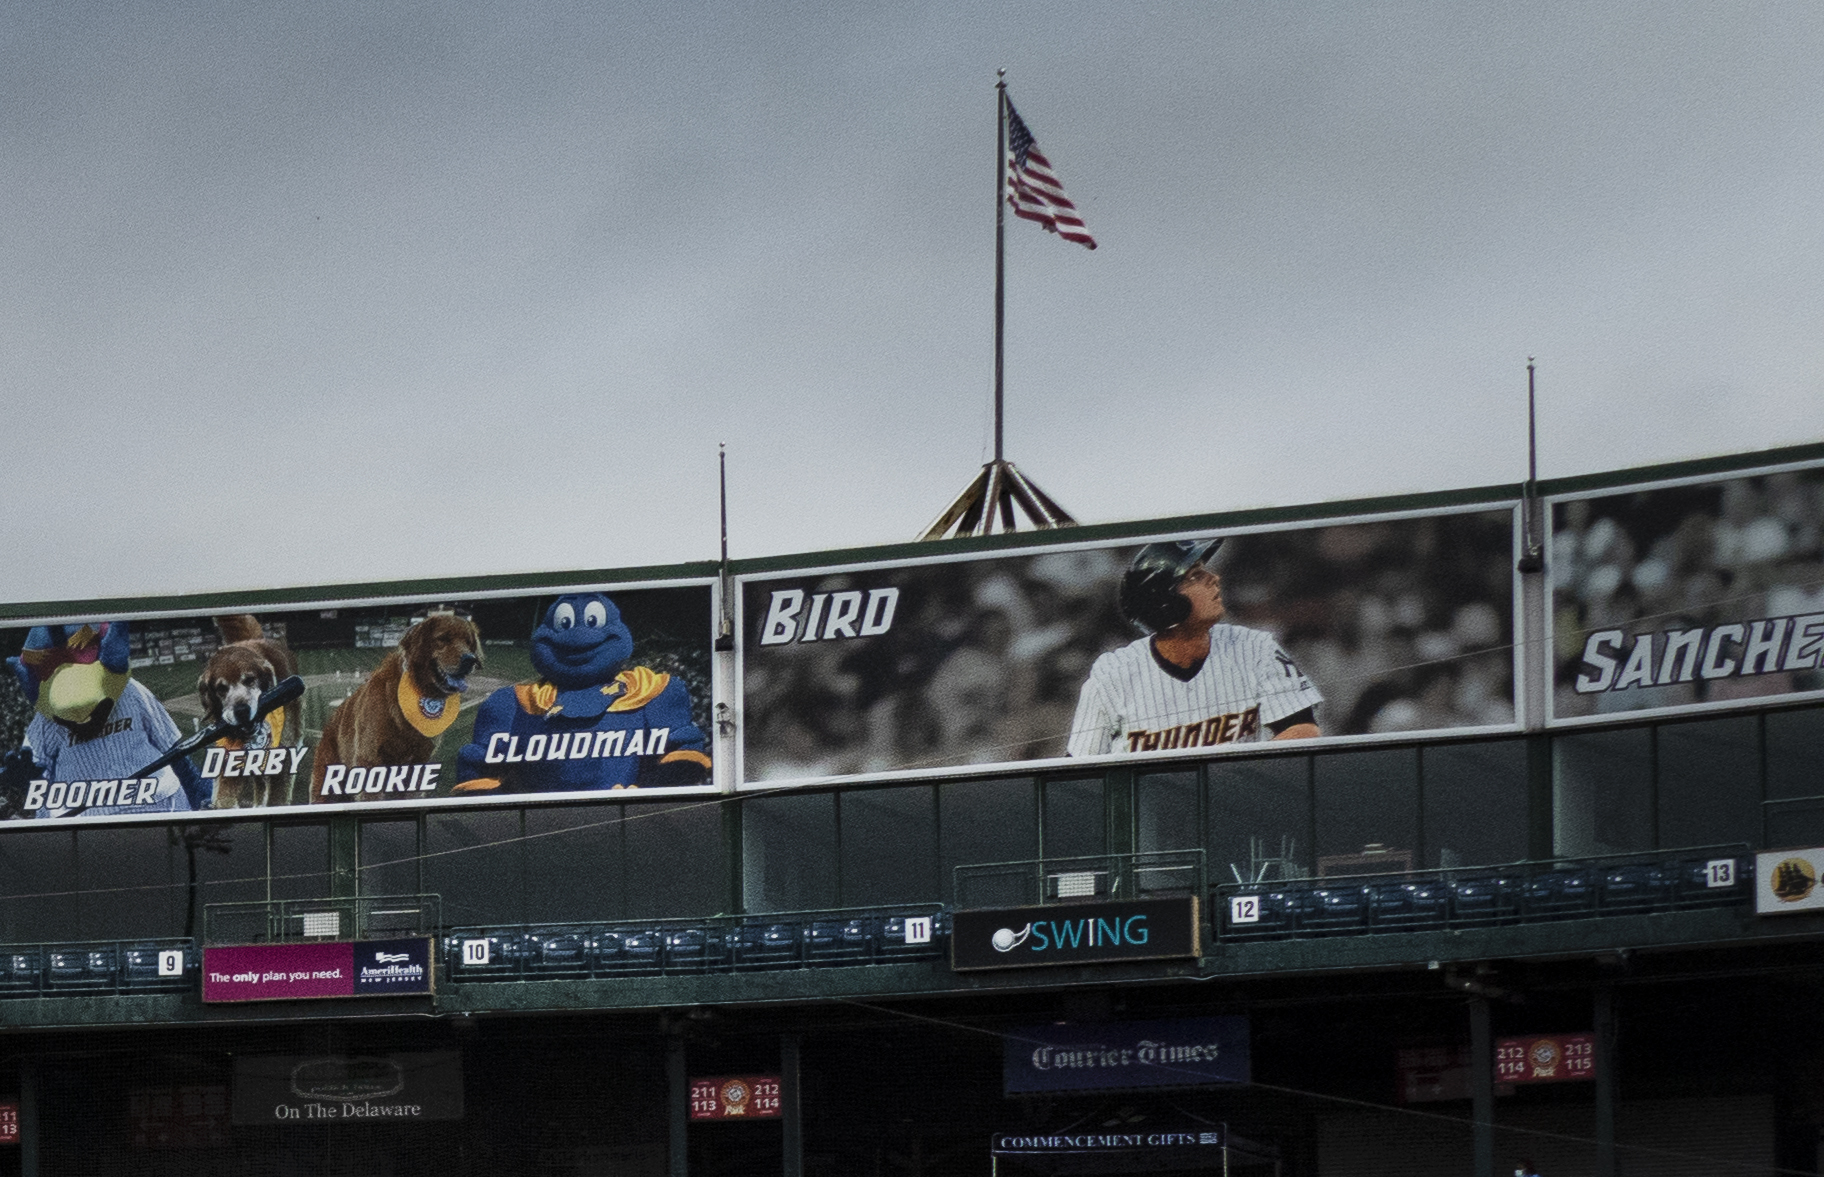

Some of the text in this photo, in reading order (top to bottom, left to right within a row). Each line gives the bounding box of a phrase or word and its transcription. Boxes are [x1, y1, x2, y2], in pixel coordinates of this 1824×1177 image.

[760, 586, 900, 647] BIRD
[1574, 612, 1824, 693] SANCHE
[1127, 703, 1260, 752] THUNDER
[484, 726, 670, 765] CLOUDMAN
[201, 746, 309, 780] DERBY
[321, 763, 442, 797] ROOKIE
[23, 775, 158, 812] BOOMER
[1711, 863, 1731, 883] 13
[1236, 901, 1254, 918] 12
[910, 922, 925, 938] 11
[1031, 915, 1149, 951] SWING
[467, 944, 484, 960] 10
[165, 955, 175, 972] 9
[360, 964, 423, 978] AmeriHealth
[209, 968, 343, 986] The only plan you need.
[1032, 1039, 1219, 1071] Courier Times
[1497, 1047, 1524, 1059] 212
[1565, 1043, 1592, 1056] 213
[1498, 1061, 1525, 1074] 114
[1566, 1057, 1592, 1070] 115
[691, 1086, 716, 1098] 211
[754, 1084, 779, 1095] 212
[275, 1101, 421, 1120] On The Delaware
[691, 1100, 717, 1111] 113
[754, 1098, 779, 1109] 114
[1001, 1132, 1196, 1150] COMMENCEMENT GIFTS
